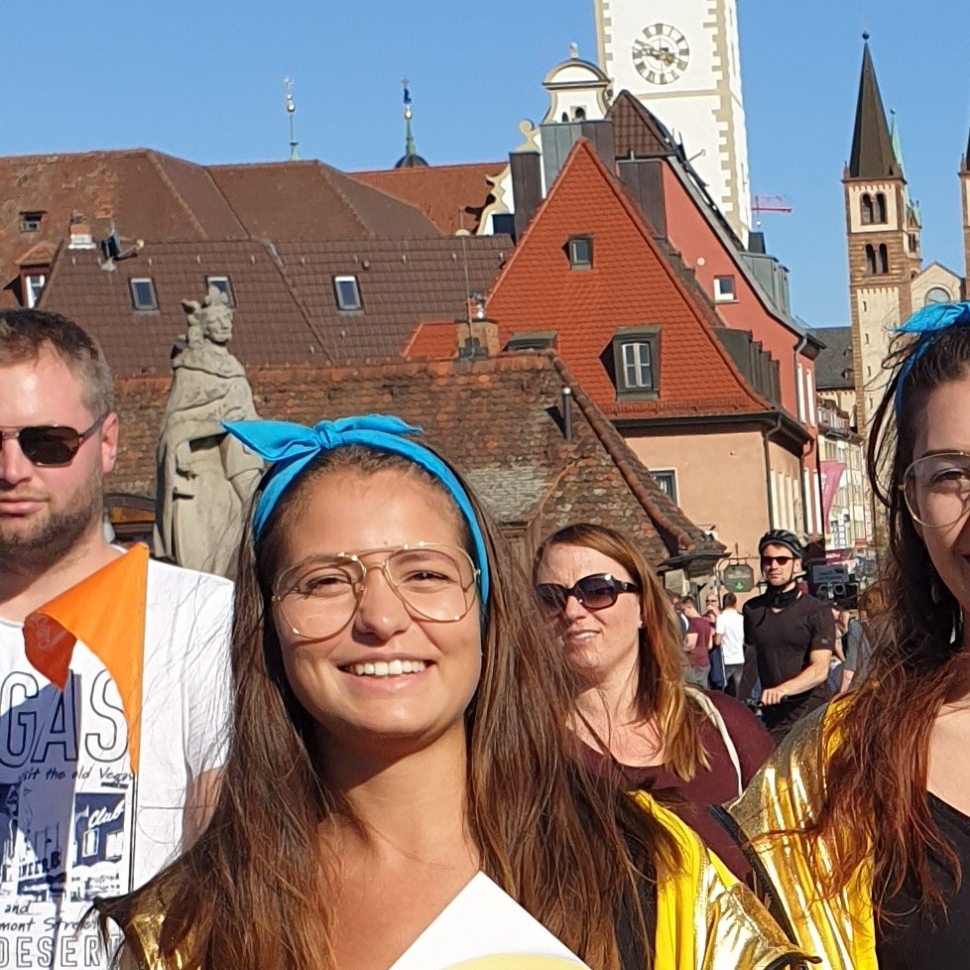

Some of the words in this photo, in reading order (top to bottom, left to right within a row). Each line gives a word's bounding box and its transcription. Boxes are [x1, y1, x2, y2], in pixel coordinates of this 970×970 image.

[45, 766, 66, 780] the
[72, 766, 93, 779] old
[88, 799, 125, 828] Club
[4, 900, 31, 914] and
